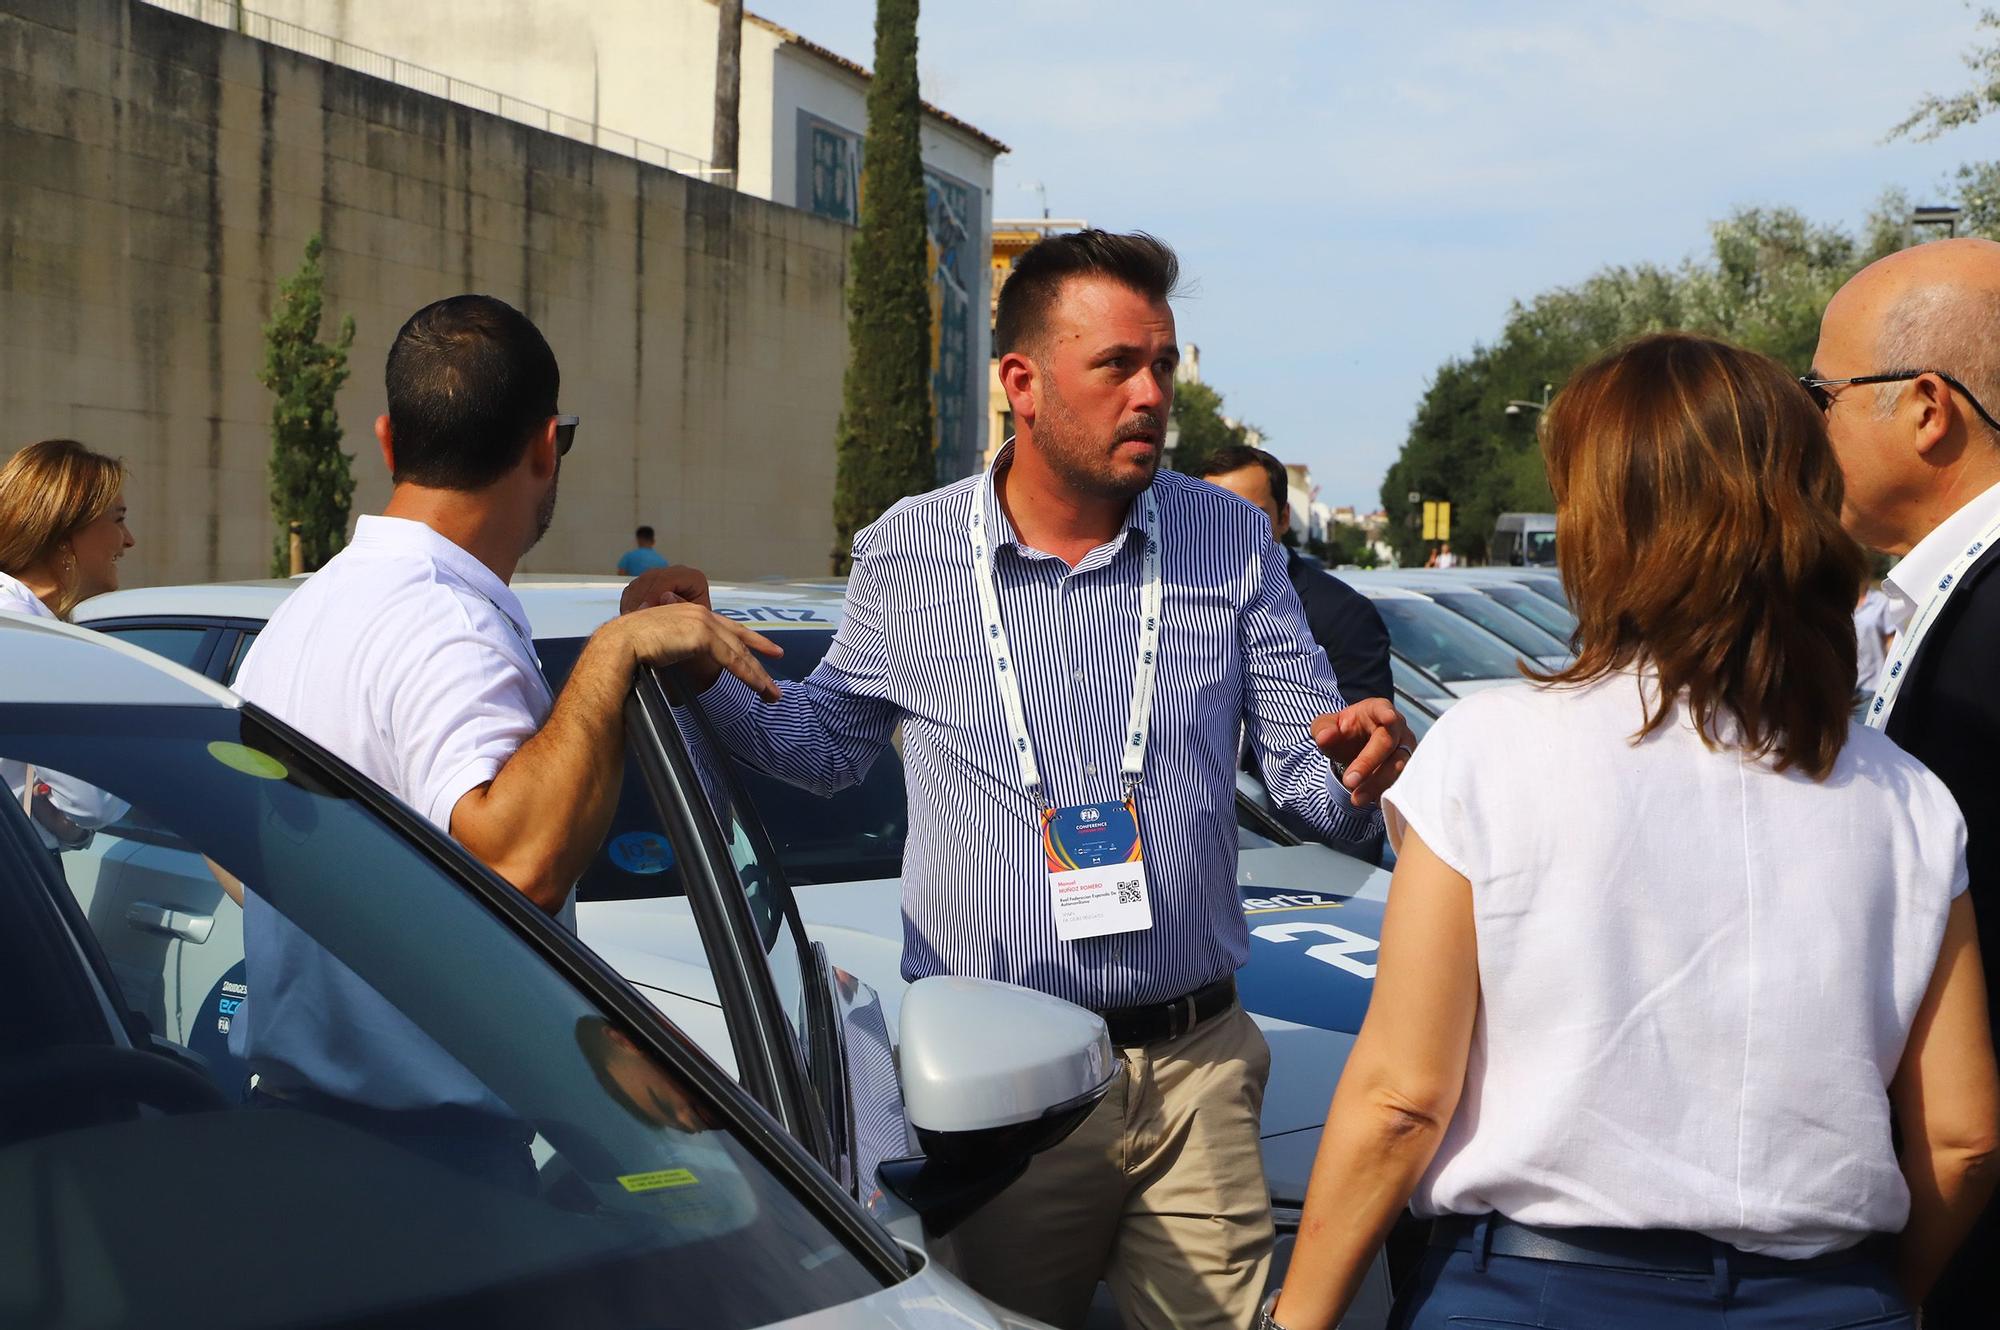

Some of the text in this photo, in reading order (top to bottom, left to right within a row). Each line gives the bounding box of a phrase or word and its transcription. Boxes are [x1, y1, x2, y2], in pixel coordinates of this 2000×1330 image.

[1966, 541, 1984, 557] FIA
[1938, 573, 1954, 592] FIA
[712, 606, 829, 622] ertz
[990, 623, 999, 639] FIA
[1146, 617, 1156, 631] FIA
[998, 657, 1008, 672] FIA
[1143, 649, 1153, 665] FIA
[1890, 660, 1903, 679] FIA
[1873, 696, 1885, 714] FIA
[1132, 731, 1143, 746] FIA
[1080, 808, 1099, 821] FIA
[1076, 822, 1107, 830] CONFERENCE
[218, 1018, 230, 1032] FIA
